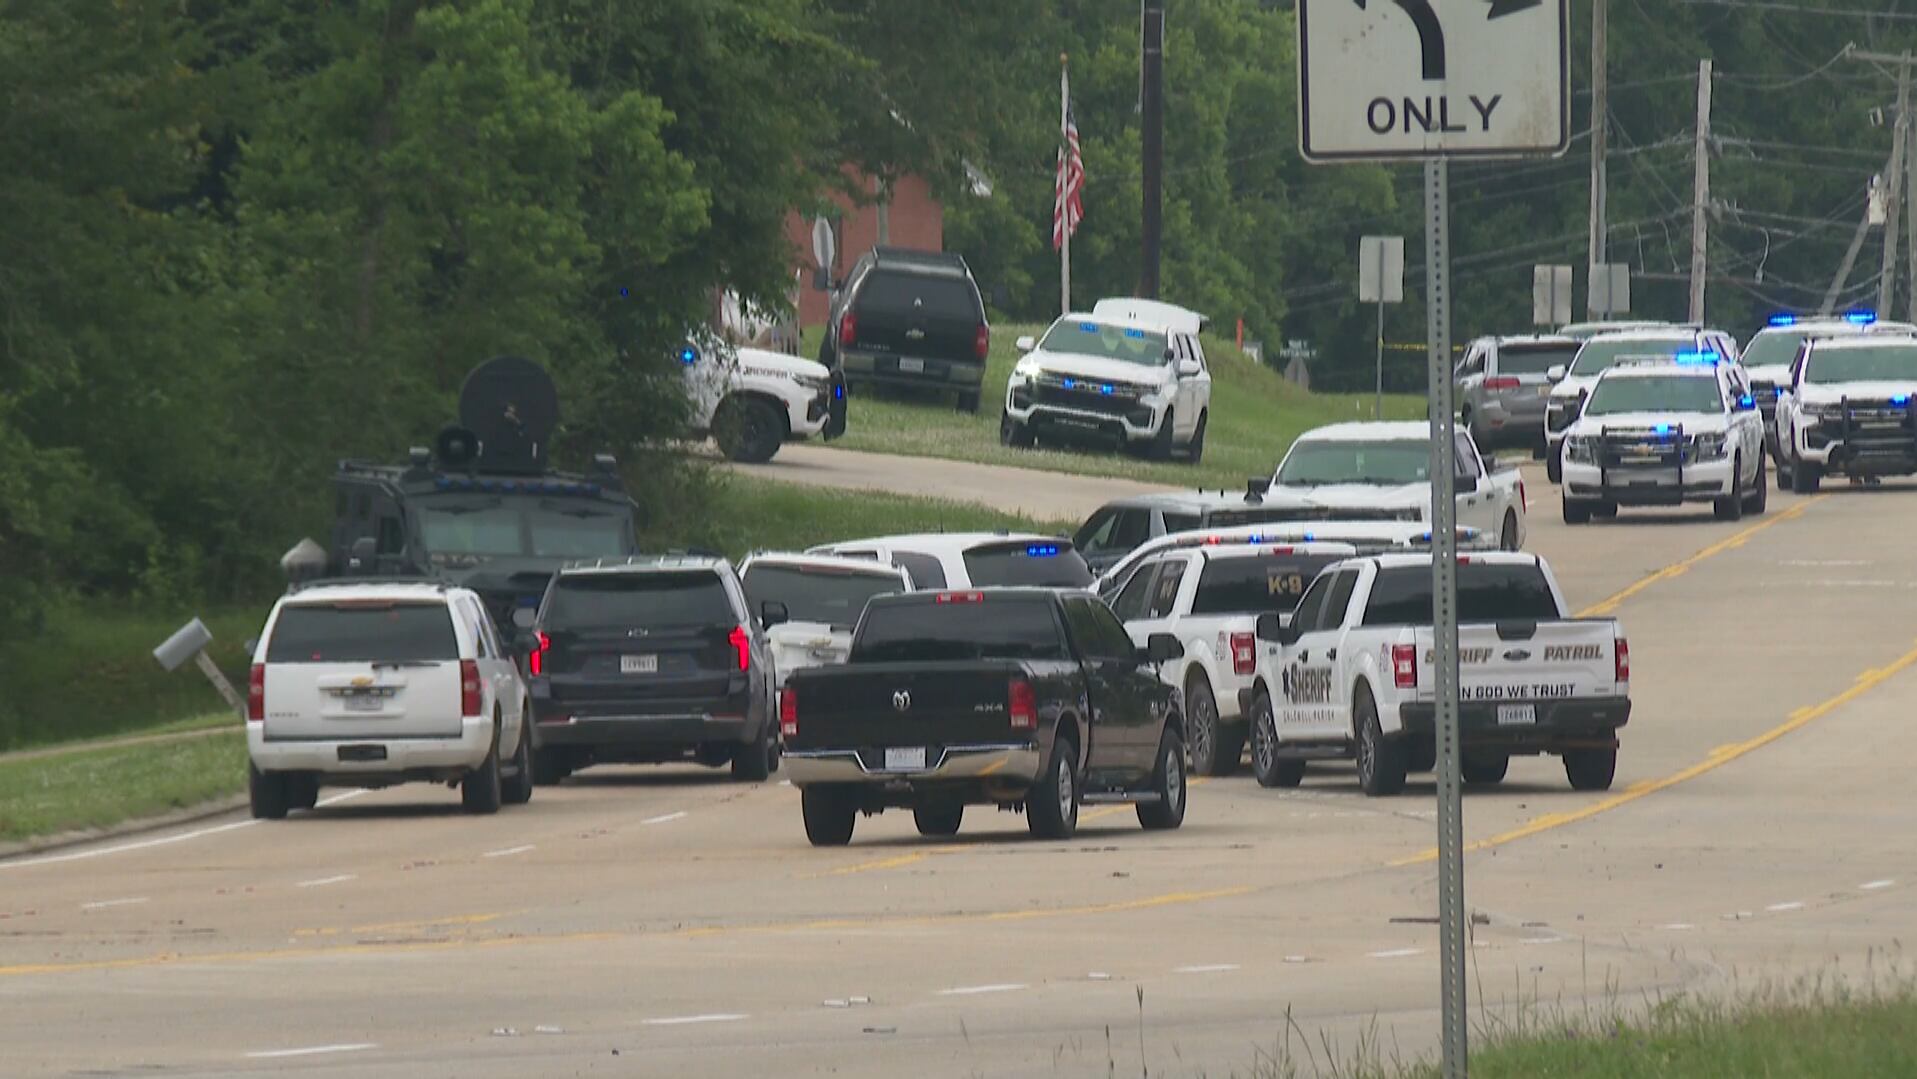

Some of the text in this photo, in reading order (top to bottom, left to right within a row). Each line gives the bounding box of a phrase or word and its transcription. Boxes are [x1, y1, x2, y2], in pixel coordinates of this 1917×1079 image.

[1367, 94, 1502, 134] ONLY
[1425, 647, 1494, 664] SRIFF
[1543, 644, 1604, 661] PATROL
[1290, 662, 1333, 705] SHERIFF
[1476, 686, 1503, 698] GOD
[1507, 685, 1528, 698] WE
[1532, 684, 1576, 698] TRUST
